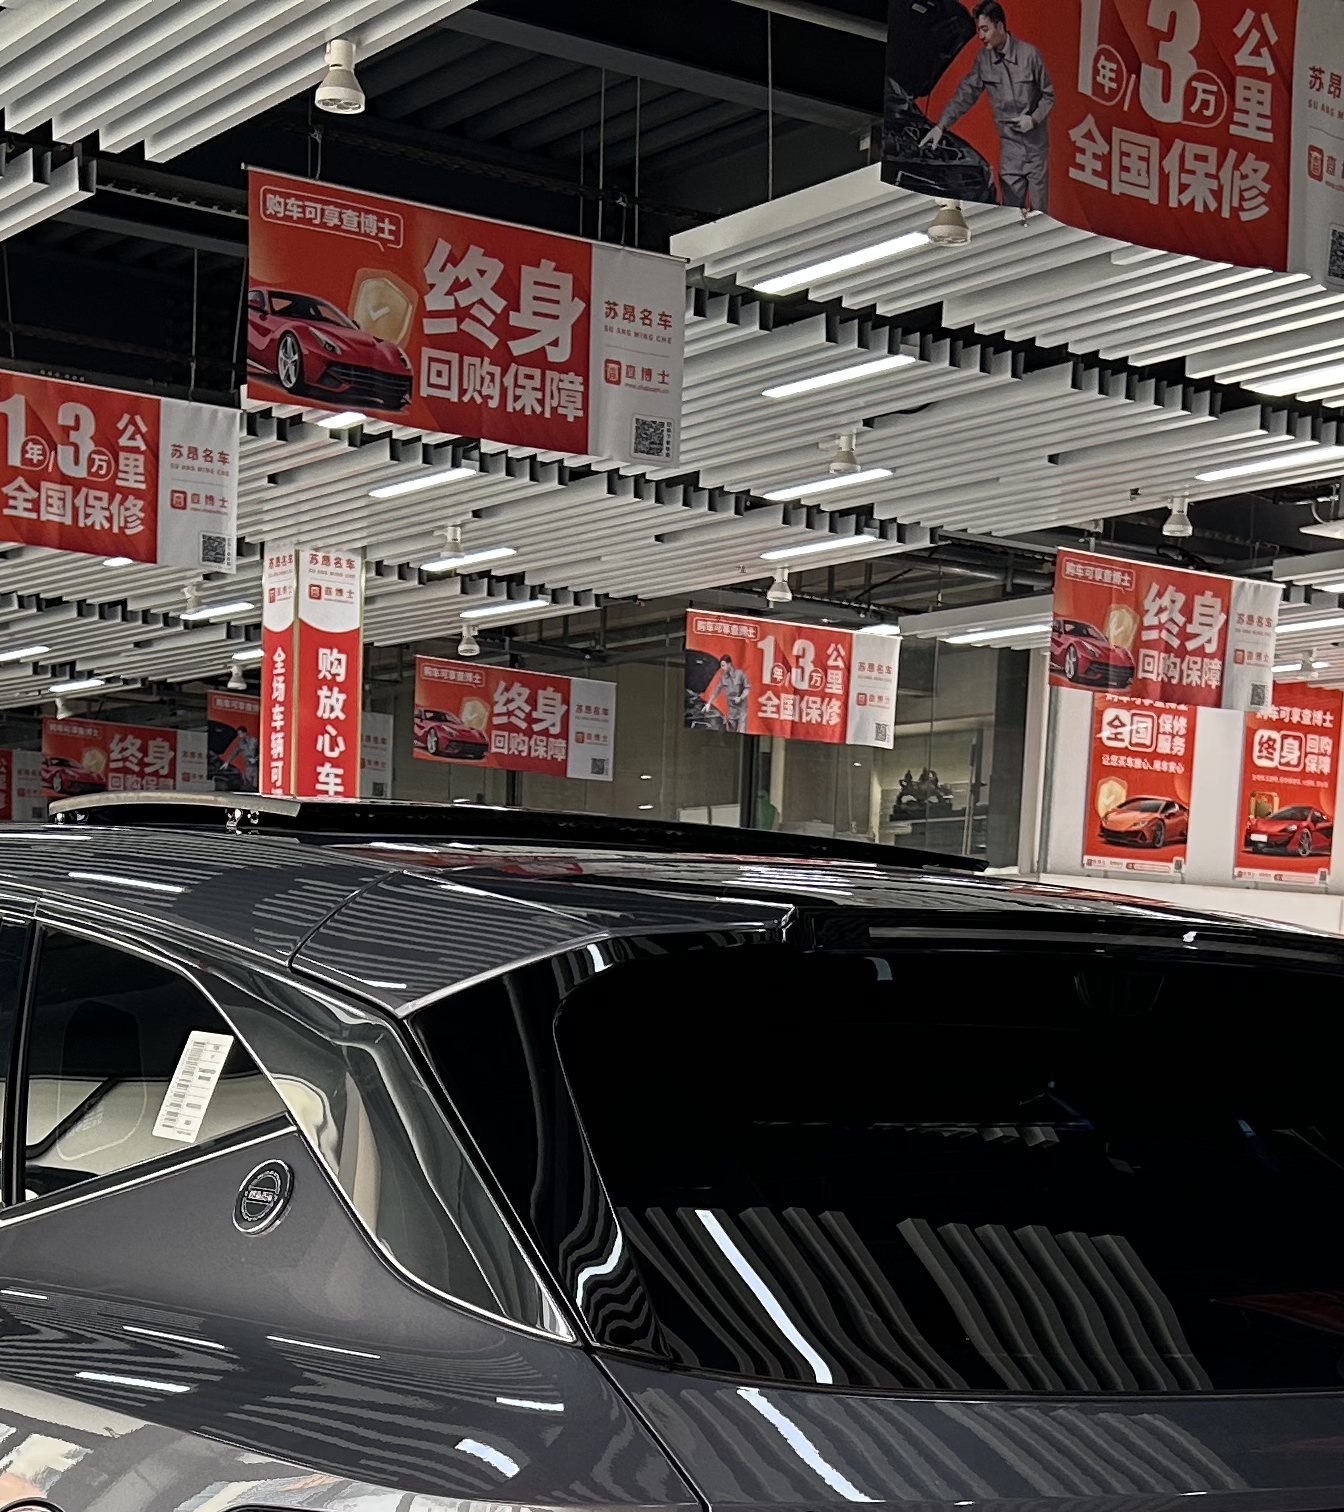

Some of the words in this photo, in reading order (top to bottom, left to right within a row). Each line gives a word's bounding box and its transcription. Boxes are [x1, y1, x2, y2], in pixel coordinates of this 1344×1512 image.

[1068, 113, 1271, 222] 全国保修
[265, 193, 397, 242] 购车可享查博士
[422, 238, 586, 363] 终身
[604, 300, 673, 330] 苏昂名车
[420, 347, 585, 422] 回购保障
[1, 476, 145, 536] 全国保修
[1141, 582, 1227, 654] 终身
[1138, 648, 1223, 690] 回购保障
[271, 647, 287, 795] 全场车辆可
[315, 648, 347, 797] 购放心车
[492, 680, 568, 734] 终身
[758, 691, 842, 725] 全国保修
[108, 733, 175, 775] 终身
[491, 730, 567, 762] 回购保障
[1255, 733, 1302, 767] 终身
